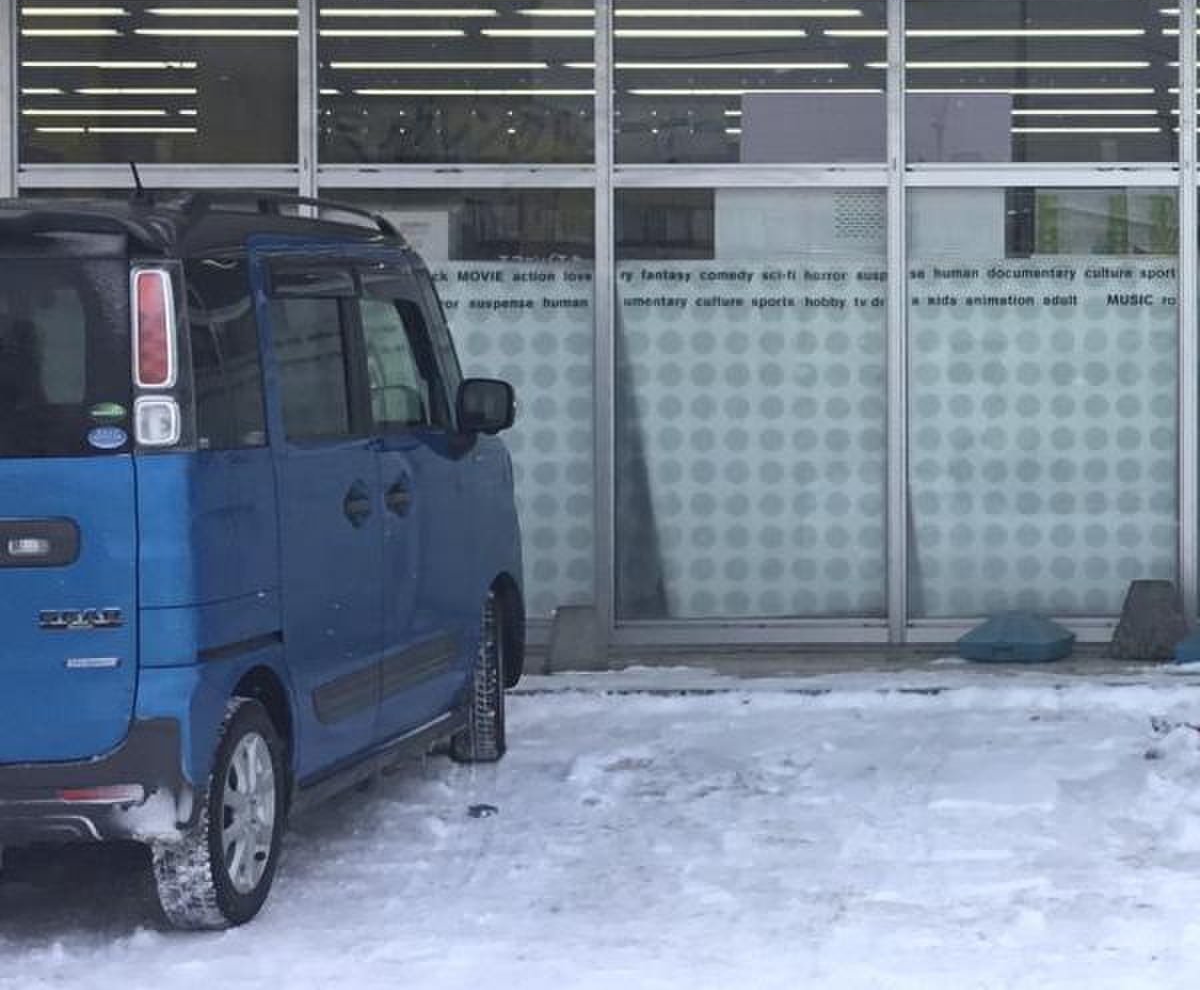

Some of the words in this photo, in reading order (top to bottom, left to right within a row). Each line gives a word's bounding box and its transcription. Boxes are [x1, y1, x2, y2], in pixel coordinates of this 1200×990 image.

[457, 270, 504, 283] MOVIE
[512, 270, 556, 283] action
[563, 270, 592, 283] love
[640, 268, 691, 285] fantasy
[699, 268, 755, 285] comedy
[762, 268, 797, 282] sci-fi
[804, 268, 849, 282] horror
[933, 267, 981, 280] human
[987, 267, 1077, 283] documentary
[1084, 266, 1133, 280] culture
[469, 297, 534, 312] suspense
[543, 295, 589, 309] human
[695, 294, 744, 308] culture
[751, 295, 796, 310] sports
[805, 294, 846, 310] hobby
[854, 294, 868, 307] tv
[927, 294, 958, 307] kids
[965, 294, 1036, 307] animation
[1043, 294, 1078, 307] adult
[1106, 293, 1153, 307] MUSIC
